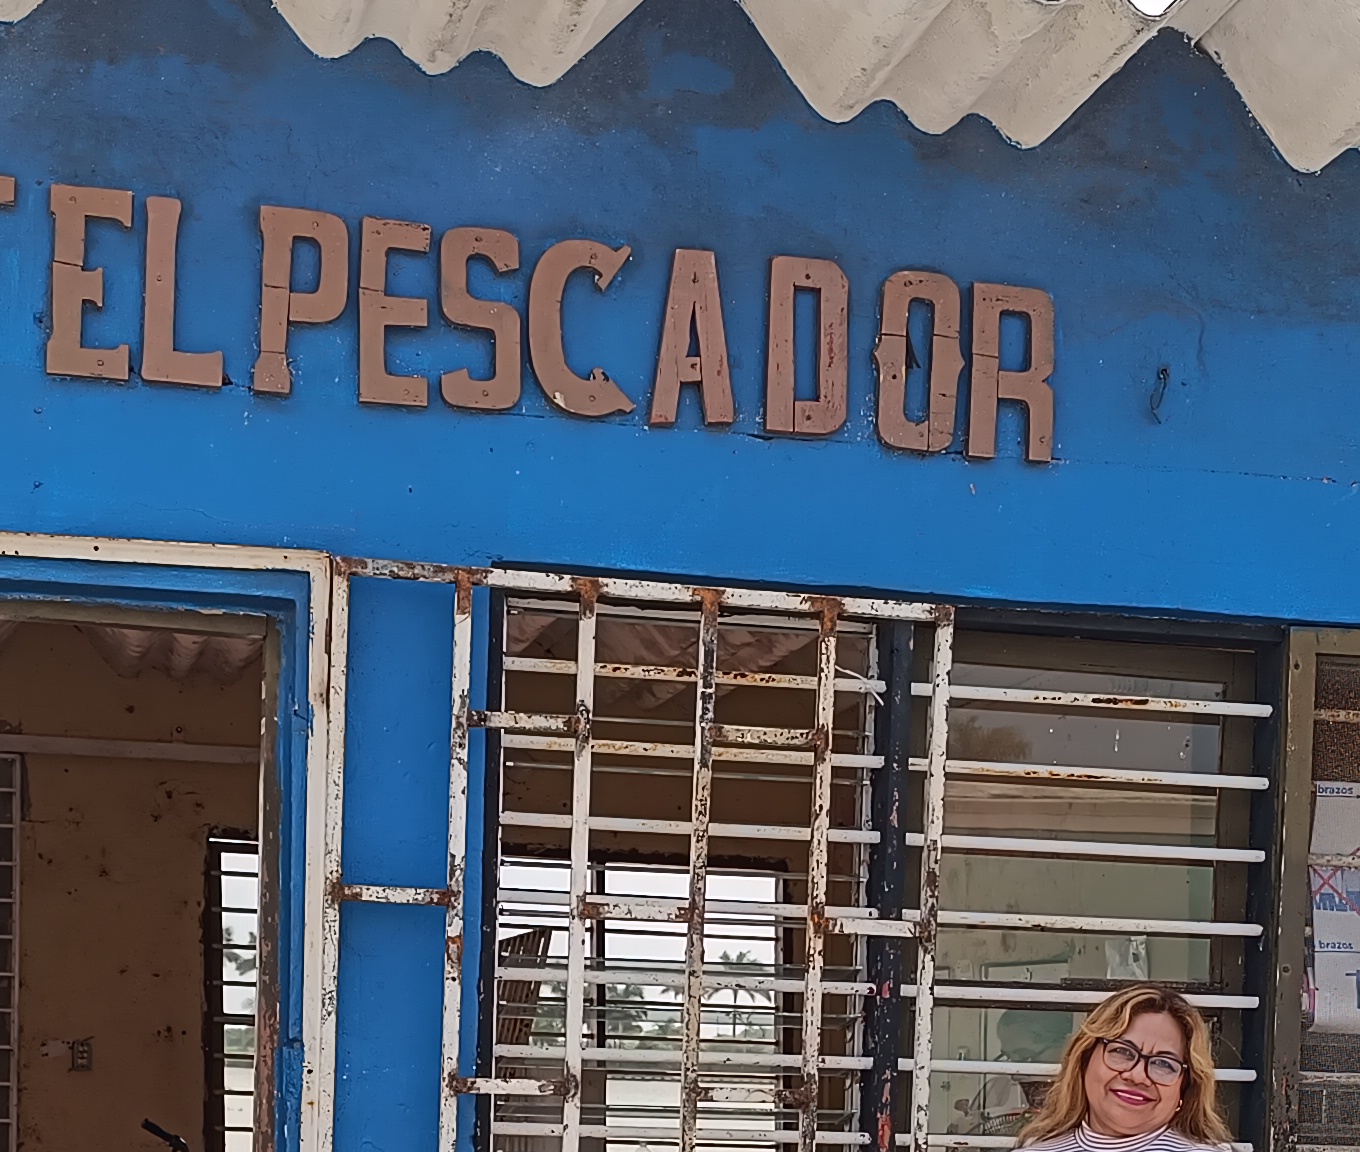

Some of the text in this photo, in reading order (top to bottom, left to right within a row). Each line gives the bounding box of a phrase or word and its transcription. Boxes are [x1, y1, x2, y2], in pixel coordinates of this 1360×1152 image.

[45, 183, 224, 387] EL
[252, 204, 1055, 462] PESCADOR
[1317, 784, 1354, 795] brazos
[1318, 940, 1354, 950] brazos
